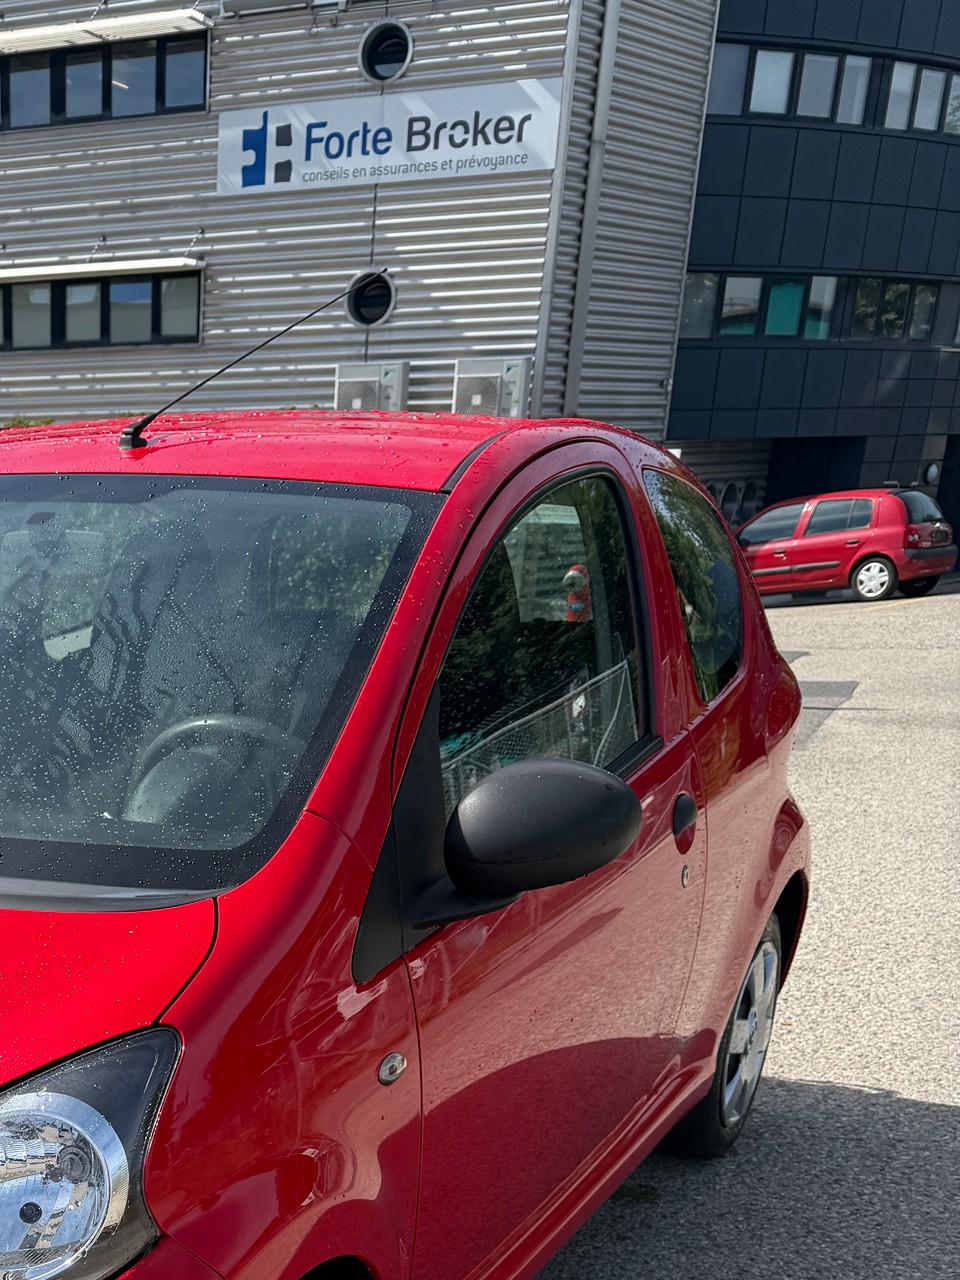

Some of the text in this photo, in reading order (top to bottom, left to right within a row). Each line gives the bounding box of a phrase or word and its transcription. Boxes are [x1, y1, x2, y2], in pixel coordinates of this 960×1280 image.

[305, 111, 532, 161] Forte Broker
[302, 153, 528, 182] conseils en assurances et prévoyance
